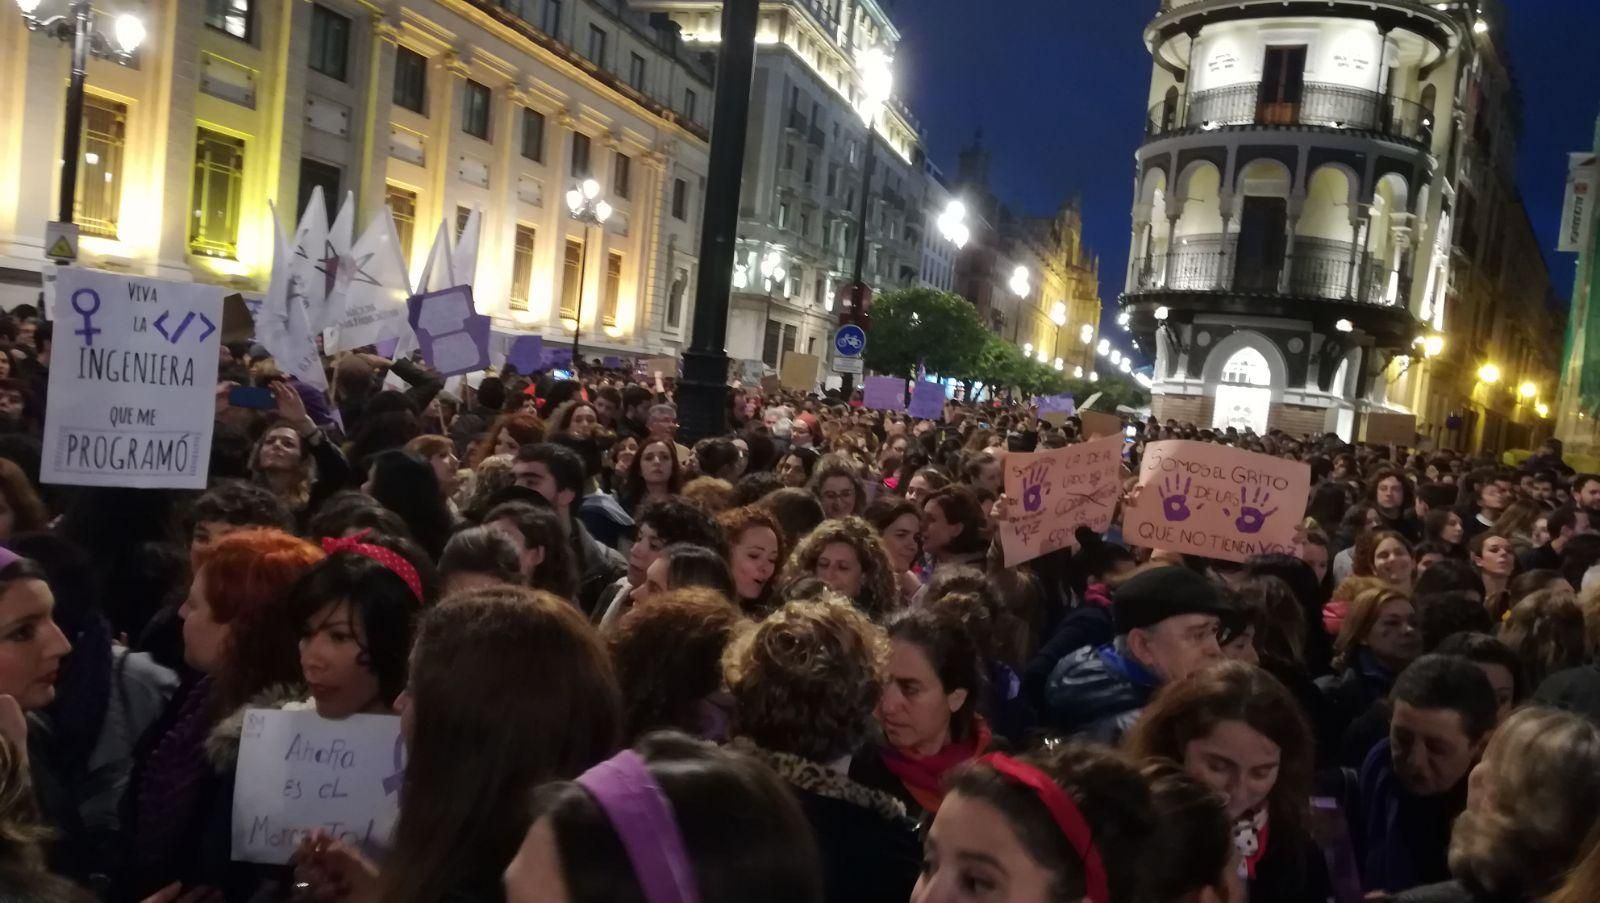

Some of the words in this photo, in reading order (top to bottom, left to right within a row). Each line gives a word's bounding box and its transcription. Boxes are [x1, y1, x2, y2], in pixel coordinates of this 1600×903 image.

[128, 282, 157, 303] VIVA
[133, 316, 147, 332] LA
[78, 347, 194, 386] INGENIERA
[110, 406, 133, 428] QUE
[137, 408, 156, 426] ME
[66, 433, 190, 472] PROGRAMÓ
[1147, 448, 1211, 477] SOMOS
[1213, 466, 1226, 480] EL
[1231, 466, 1288, 491] GRITO
[1194, 485, 1214, 500] DE
[1216, 489, 1239, 506] LAS
[1138, 522, 1176, 541] QUE
[1179, 531, 1207, 546] NO
[1209, 534, 1256, 555] TIENEN
